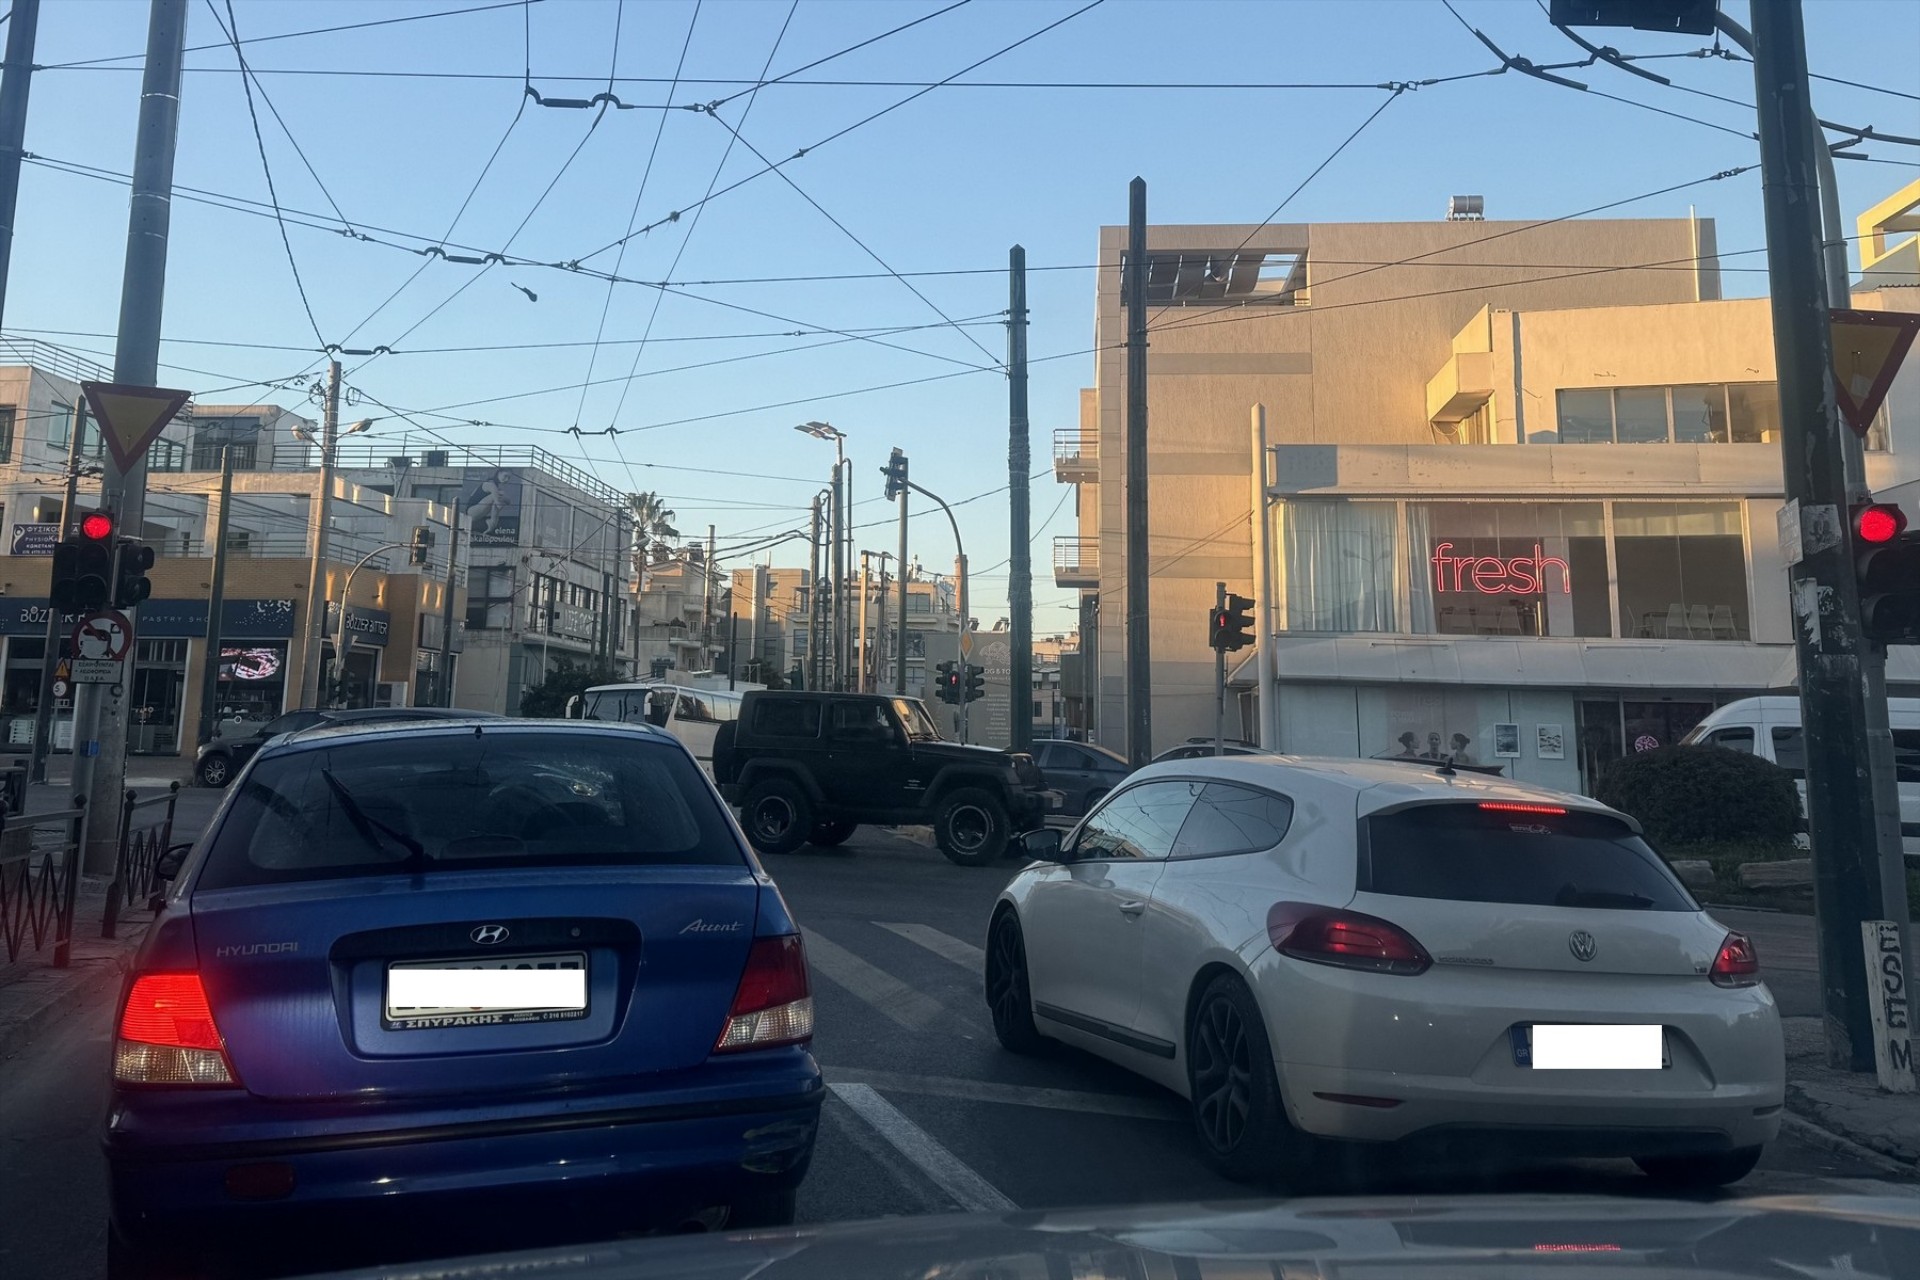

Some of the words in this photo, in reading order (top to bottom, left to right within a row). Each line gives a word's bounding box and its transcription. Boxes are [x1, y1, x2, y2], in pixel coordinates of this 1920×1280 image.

[1431, 542, 1572, 595] fresh
[142, 615, 182, 623] PASTRY
[678, 918, 745, 935] Accent
[216, 941, 299, 958] HYUNDAI
[405, 1014, 504, 1029] ΣΠΥΡΑΚΗΣ
[1516, 1047, 1529, 1058] GR
